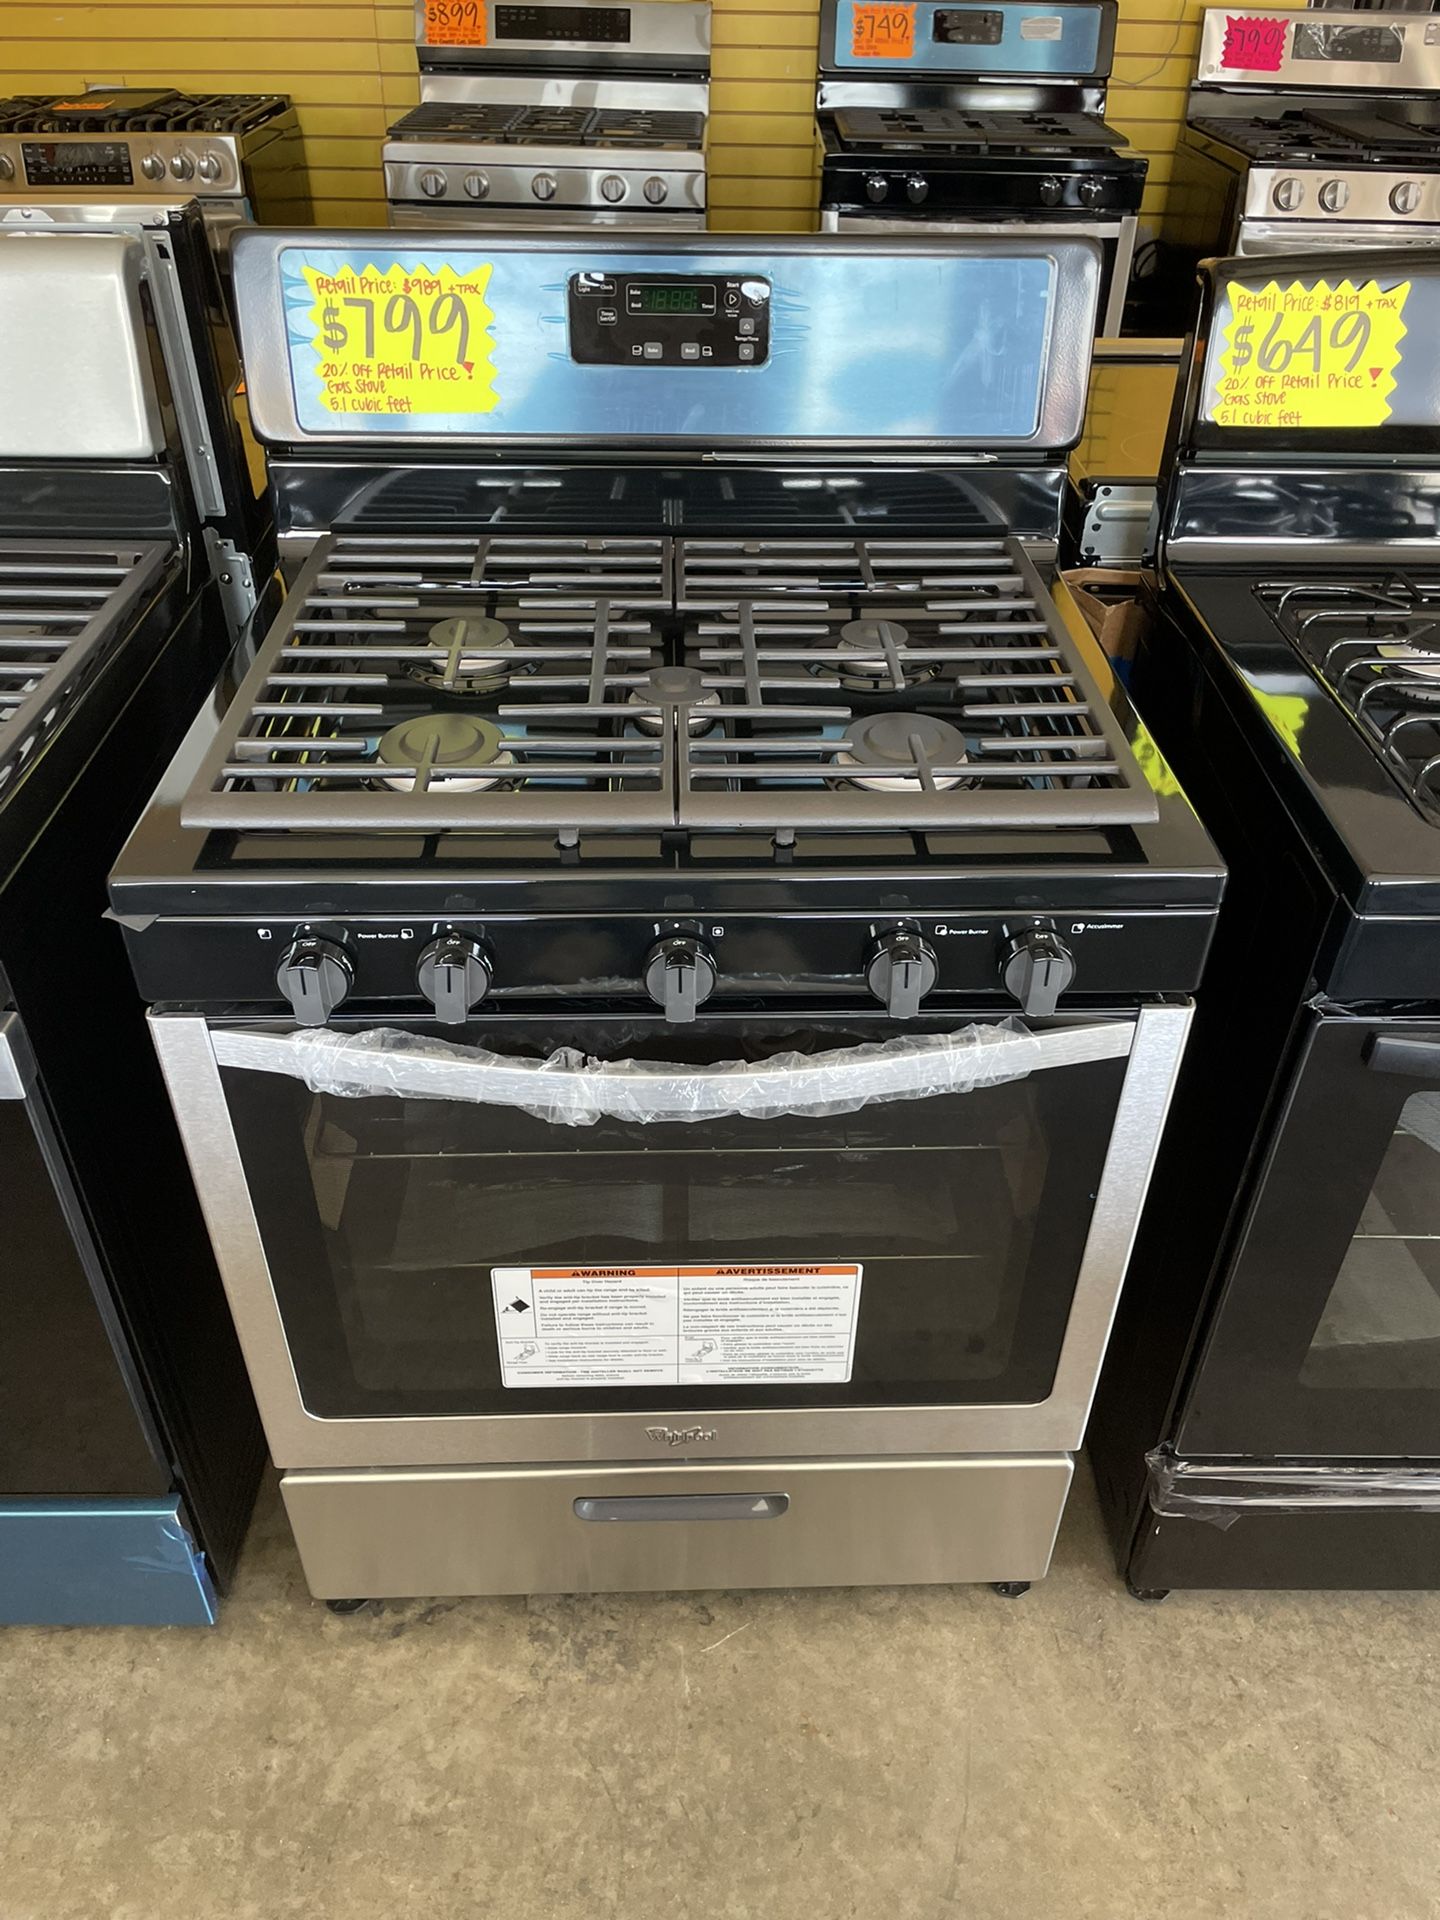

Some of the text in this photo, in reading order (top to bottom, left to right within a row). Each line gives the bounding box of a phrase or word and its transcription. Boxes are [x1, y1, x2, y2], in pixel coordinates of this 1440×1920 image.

[856, 13, 908, 39] $749
[1224, 28, 1281, 56] $799
[316, 276, 356, 295] Retail
[360, 277, 397, 294] Price:
[403, 278, 442, 296] $989
[1237, 294, 1276, 312] Retail
[1284, 294, 1319, 312] Price:
[1320, 294, 1360, 311] $819
[322, 292, 470, 365] $799
[1232, 311, 1372, 374] $649
[322, 362, 348, 378] 20%
[378, 362, 414, 380] Retail
[327, 378, 386, 394] Gas Stove
[1224, 376, 1250, 391] 20%
[1281, 374, 1320, 389] Retail
[330, 398, 347, 412] 5.1
[386, 395, 412, 413] feet
[1224, 391, 1286, 405] Gas Stove
[1220, 410, 1236, 424] 5.1
[1278, 410, 1302, 426] feet
[645, 1426, 717, 1446] Whirlpool
